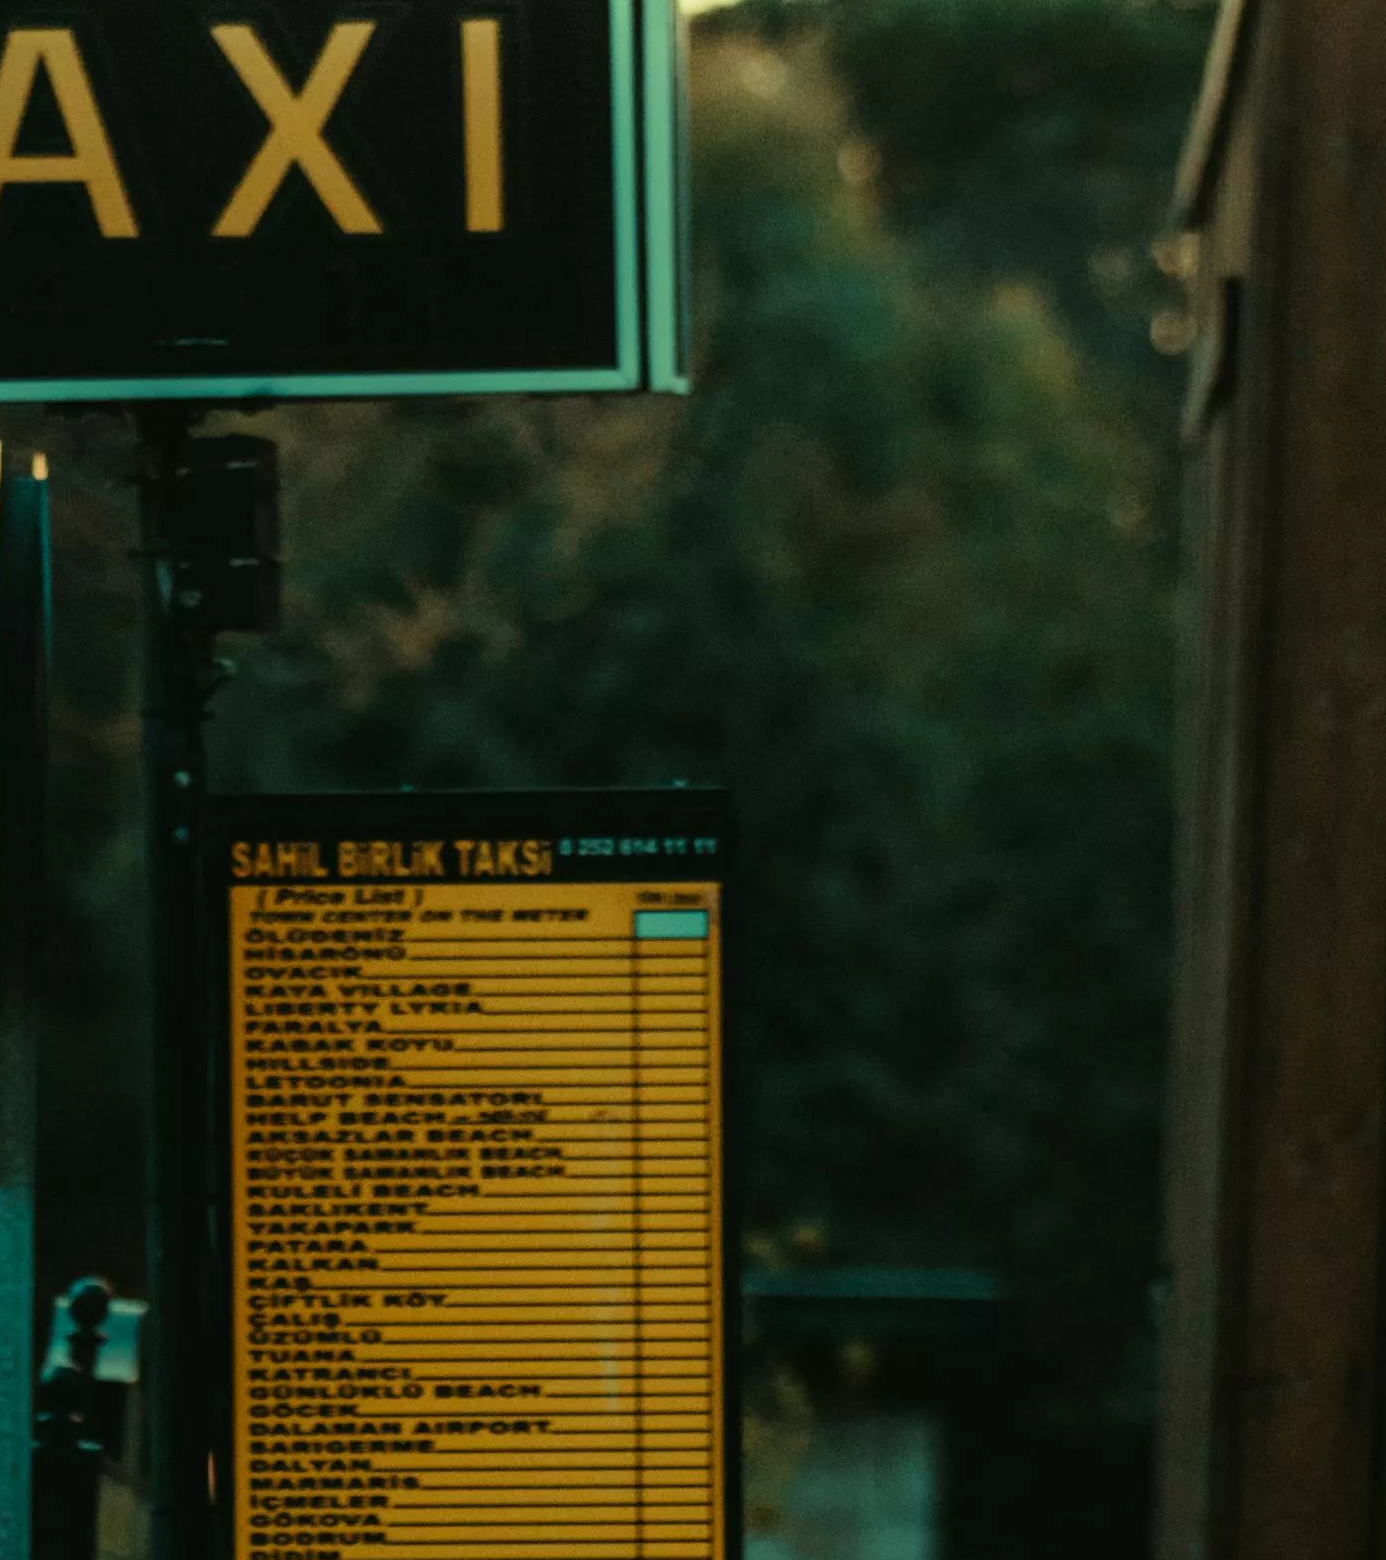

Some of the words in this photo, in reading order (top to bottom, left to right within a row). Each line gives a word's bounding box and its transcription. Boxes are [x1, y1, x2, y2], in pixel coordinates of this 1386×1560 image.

[275, 888, 346, 905] Price
[355, 888, 406, 905] List
[250, 910, 315, 923] TOWN
[323, 910, 411, 923] CENTER
[419, 910, 453, 923] ON
[460, 910, 504, 923] THE
[514, 909, 589, 922] METER
[245, 967, 362, 979] OVACIK
[245, 985, 327, 997] KAYA
[338, 983, 471, 997] VILLAGE
[245, 1004, 379, 1016] LIBERTY
[391, 1002, 484, 1015] LYKIA
[245, 1021, 383, 1033] FARALYA
[245, 1040, 355, 1052] KABAK
[246, 1057, 390, 1071] HILLSIDE
[246, 1076, 406, 1089] LETOONIA
[246, 1094, 351, 1107] BARUT
[365, 1093, 542, 1107] SENSATORI
[246, 1113, 328, 1125] HELP
[339, 1112, 445, 1124] BEACH
[246, 1131, 415, 1143] AKSAZLAR
[426, 1130, 533, 1142] BEACH
[480, 1147, 562, 1160] BEACH
[481, 1165, 565, 1178] BEACH
[373, 1184, 480, 1197] BEACH
[247, 1222, 416, 1235] YAKAPARK
[247, 1240, 368, 1253] PATARA
[247, 1258, 380, 1271] KALKAN
[383, 1293, 447, 1308] KÖY
[249, 1350, 355, 1362] TUANA
[248, 1368, 413, 1381] KATRANCI
[434, 1384, 542, 1398] BEACH
[249, 1404, 358, 1418] GÖCEK
[249, 1423, 402, 1436] DALAMAN
[413, 1420, 551, 1434] AIRPORT
[249, 1441, 435, 1454] SARIGERME
[249, 1460, 372, 1472] DALYAN
[250, 1512, 381, 1528] GÖKOVA
[250, 1532, 386, 1546] BODRUM
